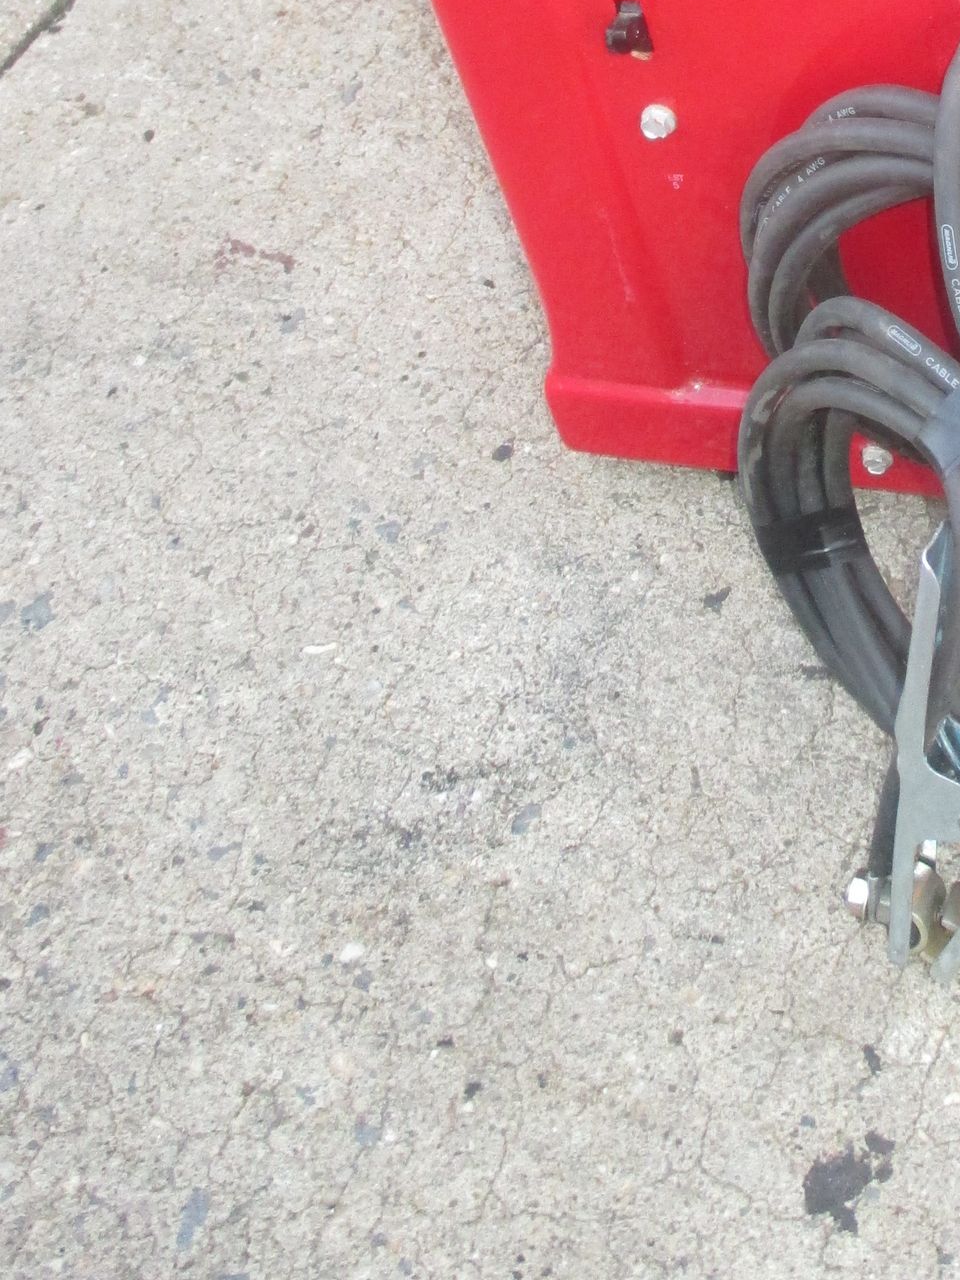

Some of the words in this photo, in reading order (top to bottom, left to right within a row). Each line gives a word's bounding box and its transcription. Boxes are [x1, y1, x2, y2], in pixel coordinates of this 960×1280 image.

[835, 106, 856, 119] AWG
[796, 175, 804, 184] 4
[806, 156, 826, 176] AWG
[925, 357, 959, 389] CABLE
